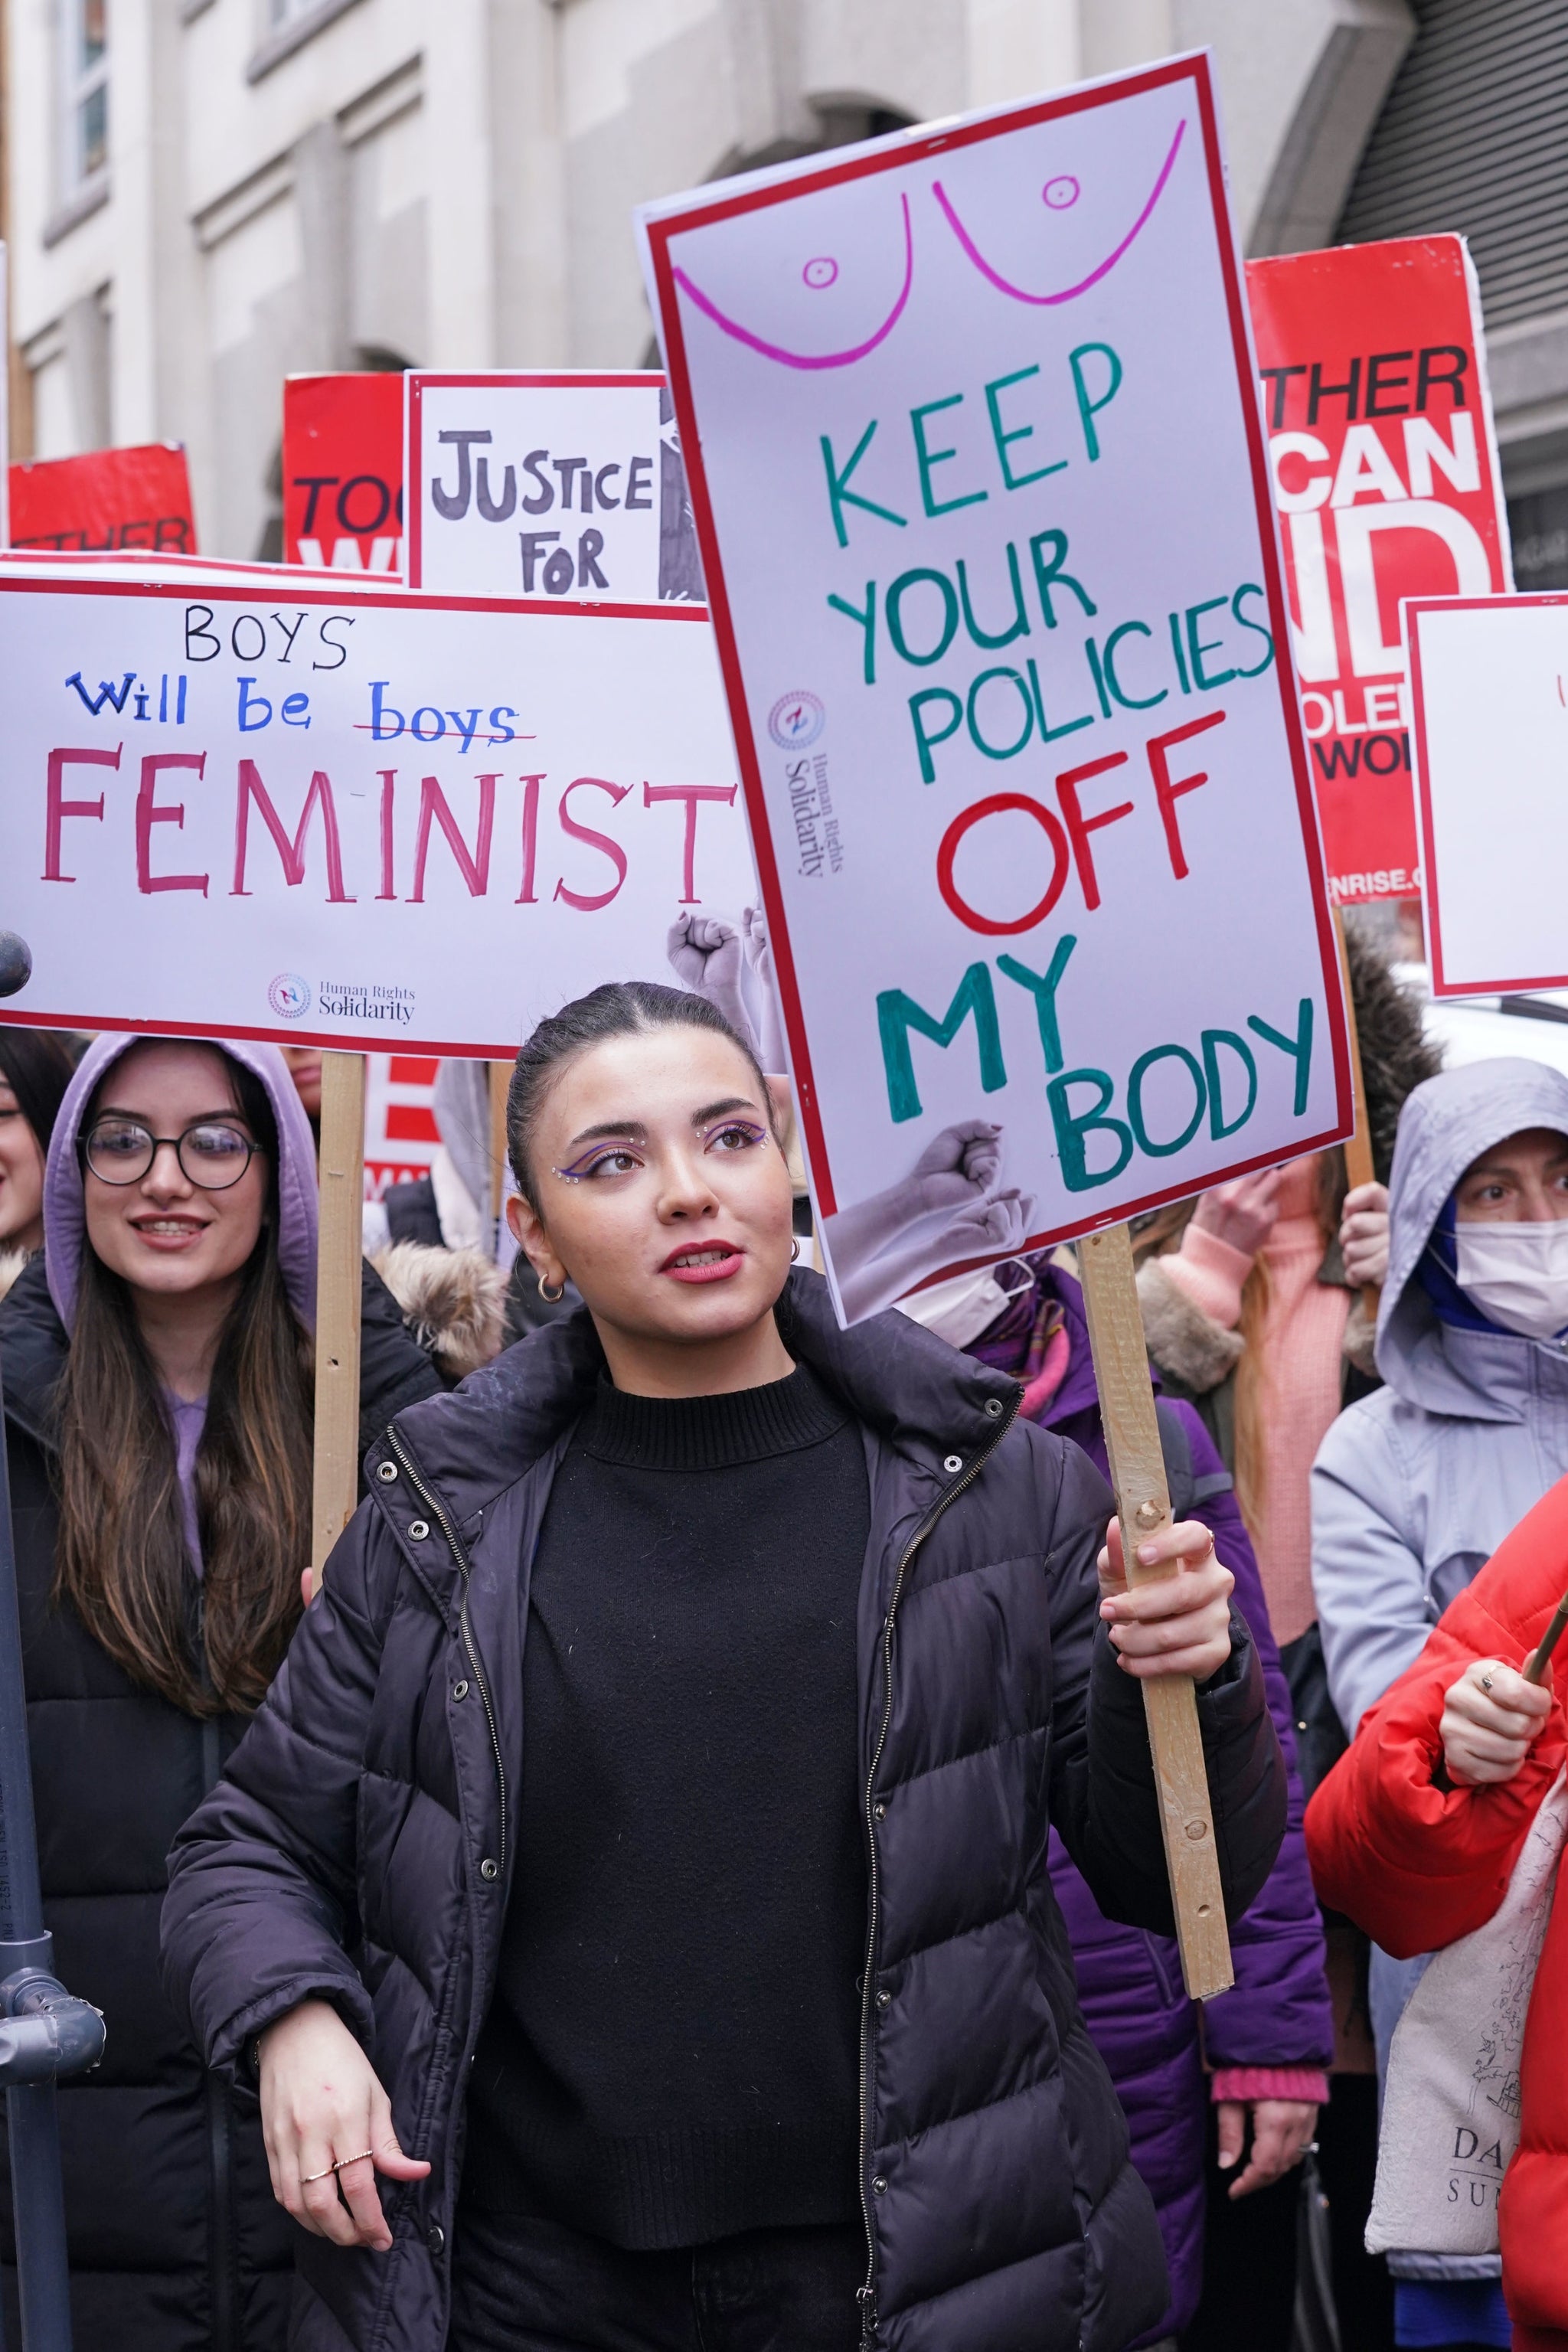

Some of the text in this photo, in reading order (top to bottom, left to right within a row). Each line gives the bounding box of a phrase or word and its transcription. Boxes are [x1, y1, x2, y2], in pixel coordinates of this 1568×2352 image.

[1259, 345, 1468, 430] THER
[432, 429, 654, 522] JUSTICE
[820, 342, 1122, 548] KEEP
[1269, 410, 1481, 514] CAN
[293, 475, 403, 534] TO
[519, 528, 609, 595] FOR
[827, 528, 1098, 684] YOUR
[185, 605, 355, 670] BOYS
[909, 583, 1275, 785] POLICIES
[237, 677, 312, 732] be
[368, 681, 521, 753] boys
[1314, 733, 1412, 780] WO
[40, 742, 738, 912] FEMINIST
[786, 759, 825, 878] Solidarity
[812, 753, 844, 874] Human Rights
[936, 710, 1226, 936] OFF
[318, 995, 415, 1025] Solidarity
[320, 981, 416, 1000] Human Rights
[876, 934, 1078, 1124] MY
[1045, 998, 1315, 1192] BODY
[1452, 2126, 1518, 2170] DA
